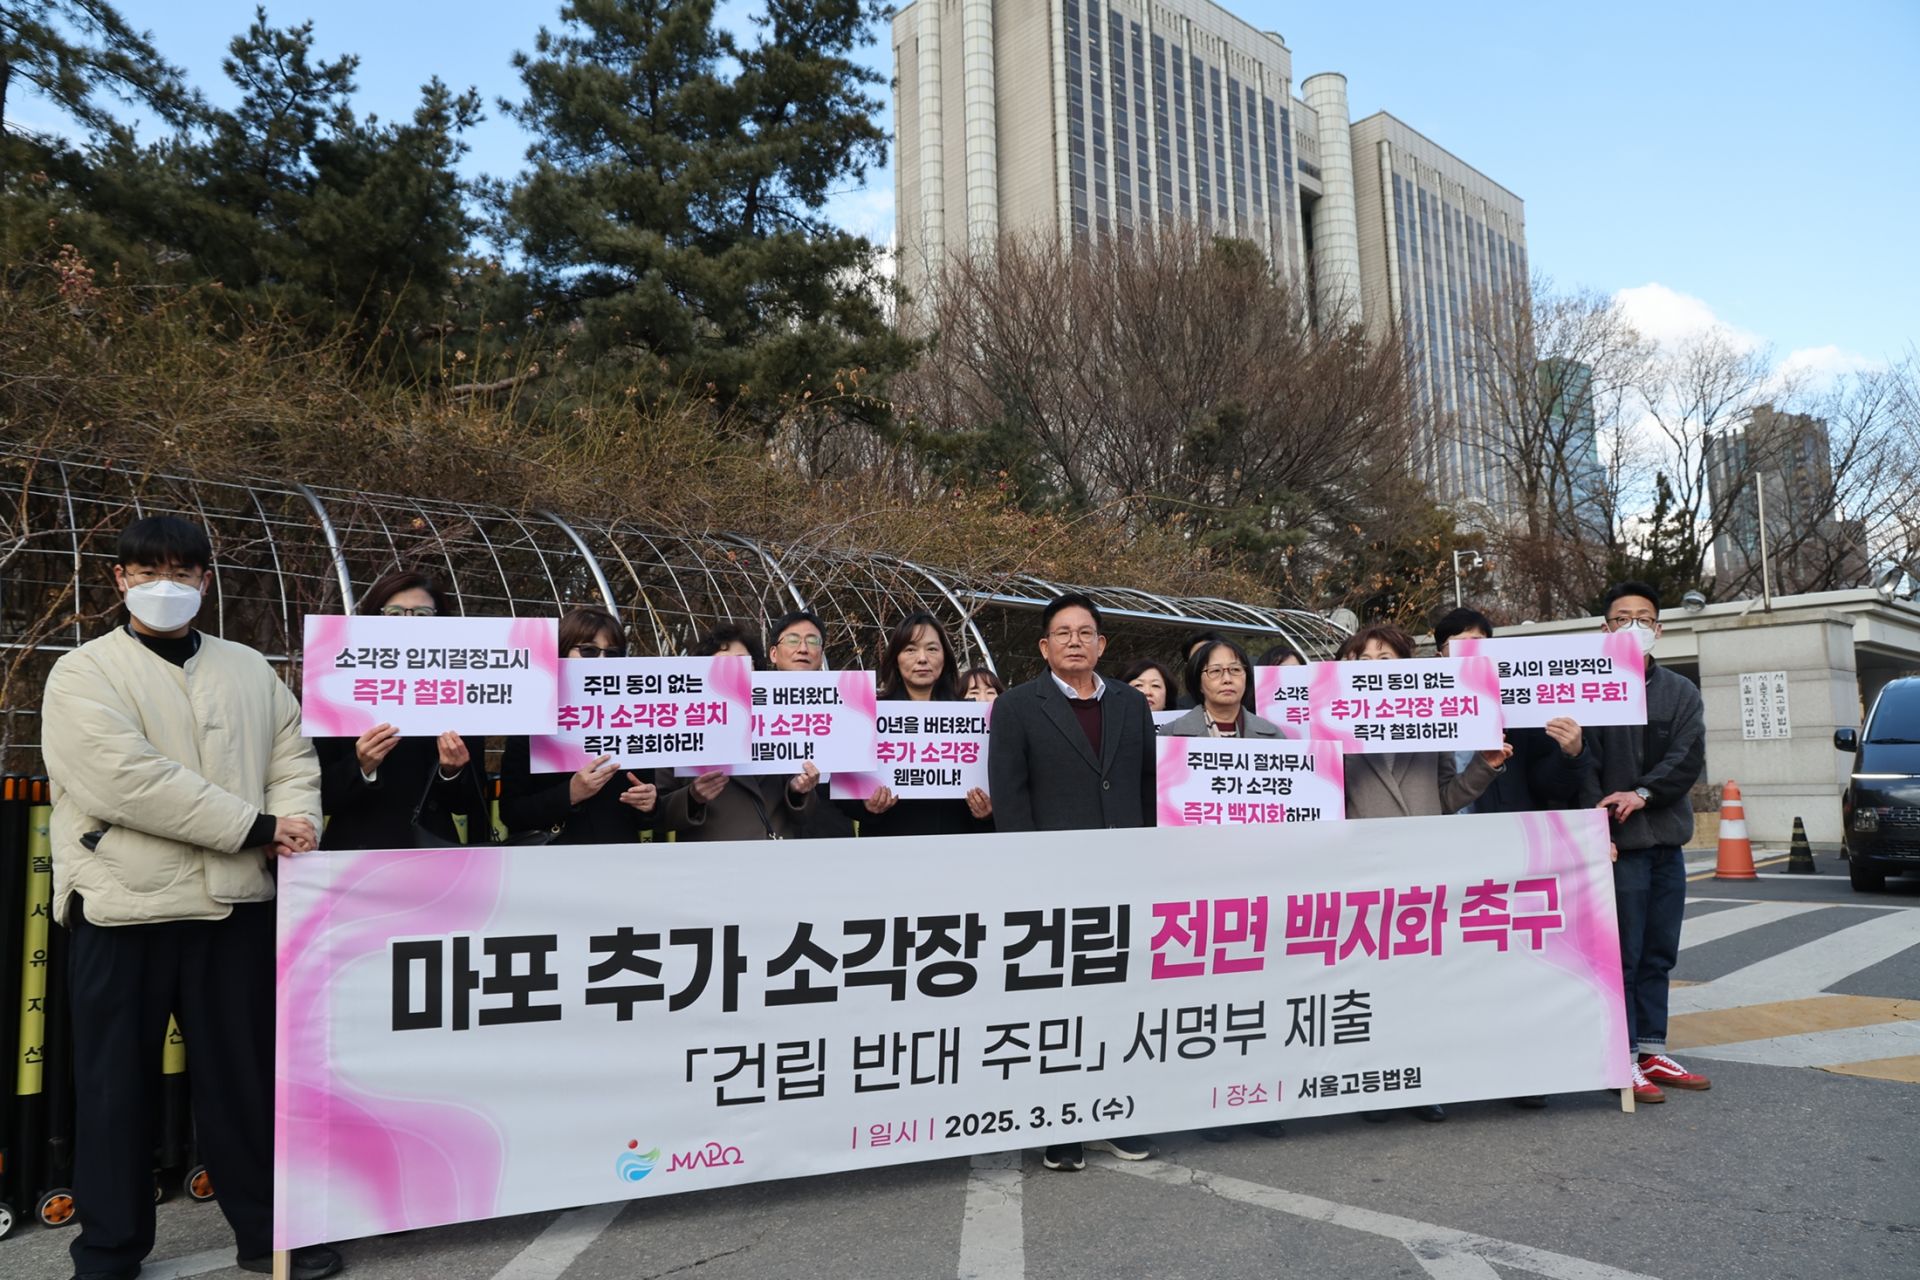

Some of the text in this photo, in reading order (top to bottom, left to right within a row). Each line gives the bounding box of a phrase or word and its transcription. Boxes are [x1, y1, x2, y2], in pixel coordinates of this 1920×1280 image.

[335, 647, 529, 671] 소각장 입지결정고시
[1498, 657, 1612, 678] 울시의 일방적인
[353, 678, 512, 706] 즉각 철회하라!
[583, 673, 703, 697] 주민 동의 없는
[1352, 672, 1455, 692] 주민 동의 없는
[1536, 682, 1575, 704] 원천
[1581, 681, 1628, 703] 무효!
[773, 686, 843, 706] 버텨왔다.
[1331, 695, 1479, 720] 추가 소각장 설치
[558, 701, 728, 731] 추가 소각장 설치
[752, 713, 832, 737] 가 소각장
[877, 716, 991, 734] 0년을 버텨왔다.
[1353, 722, 1458, 741] 즉각 철회하라!
[584, 732, 704, 756] 즉각 철회하라!
[877, 741, 980, 764] 추가 소각장
[1187, 752, 1315, 772] 주민무시 절차무시
[894, 768, 961, 786] 웬말이냐!
[1211, 776, 1293, 796] 추가 소각장
[1184, 801, 1223, 824] 즉각
[391, 877, 1563, 1032] 마포 추가 소각장 건립 전면 백지화 촉구
[853, 1026, 960, 1094] 반대
[1123, 1000, 1267, 1064] 서명부
[1284, 988, 1373, 1048] 제출
[1298, 1066, 1422, 1100] 서울고등법원
[1091, 1095, 1135, 1123] (수)
